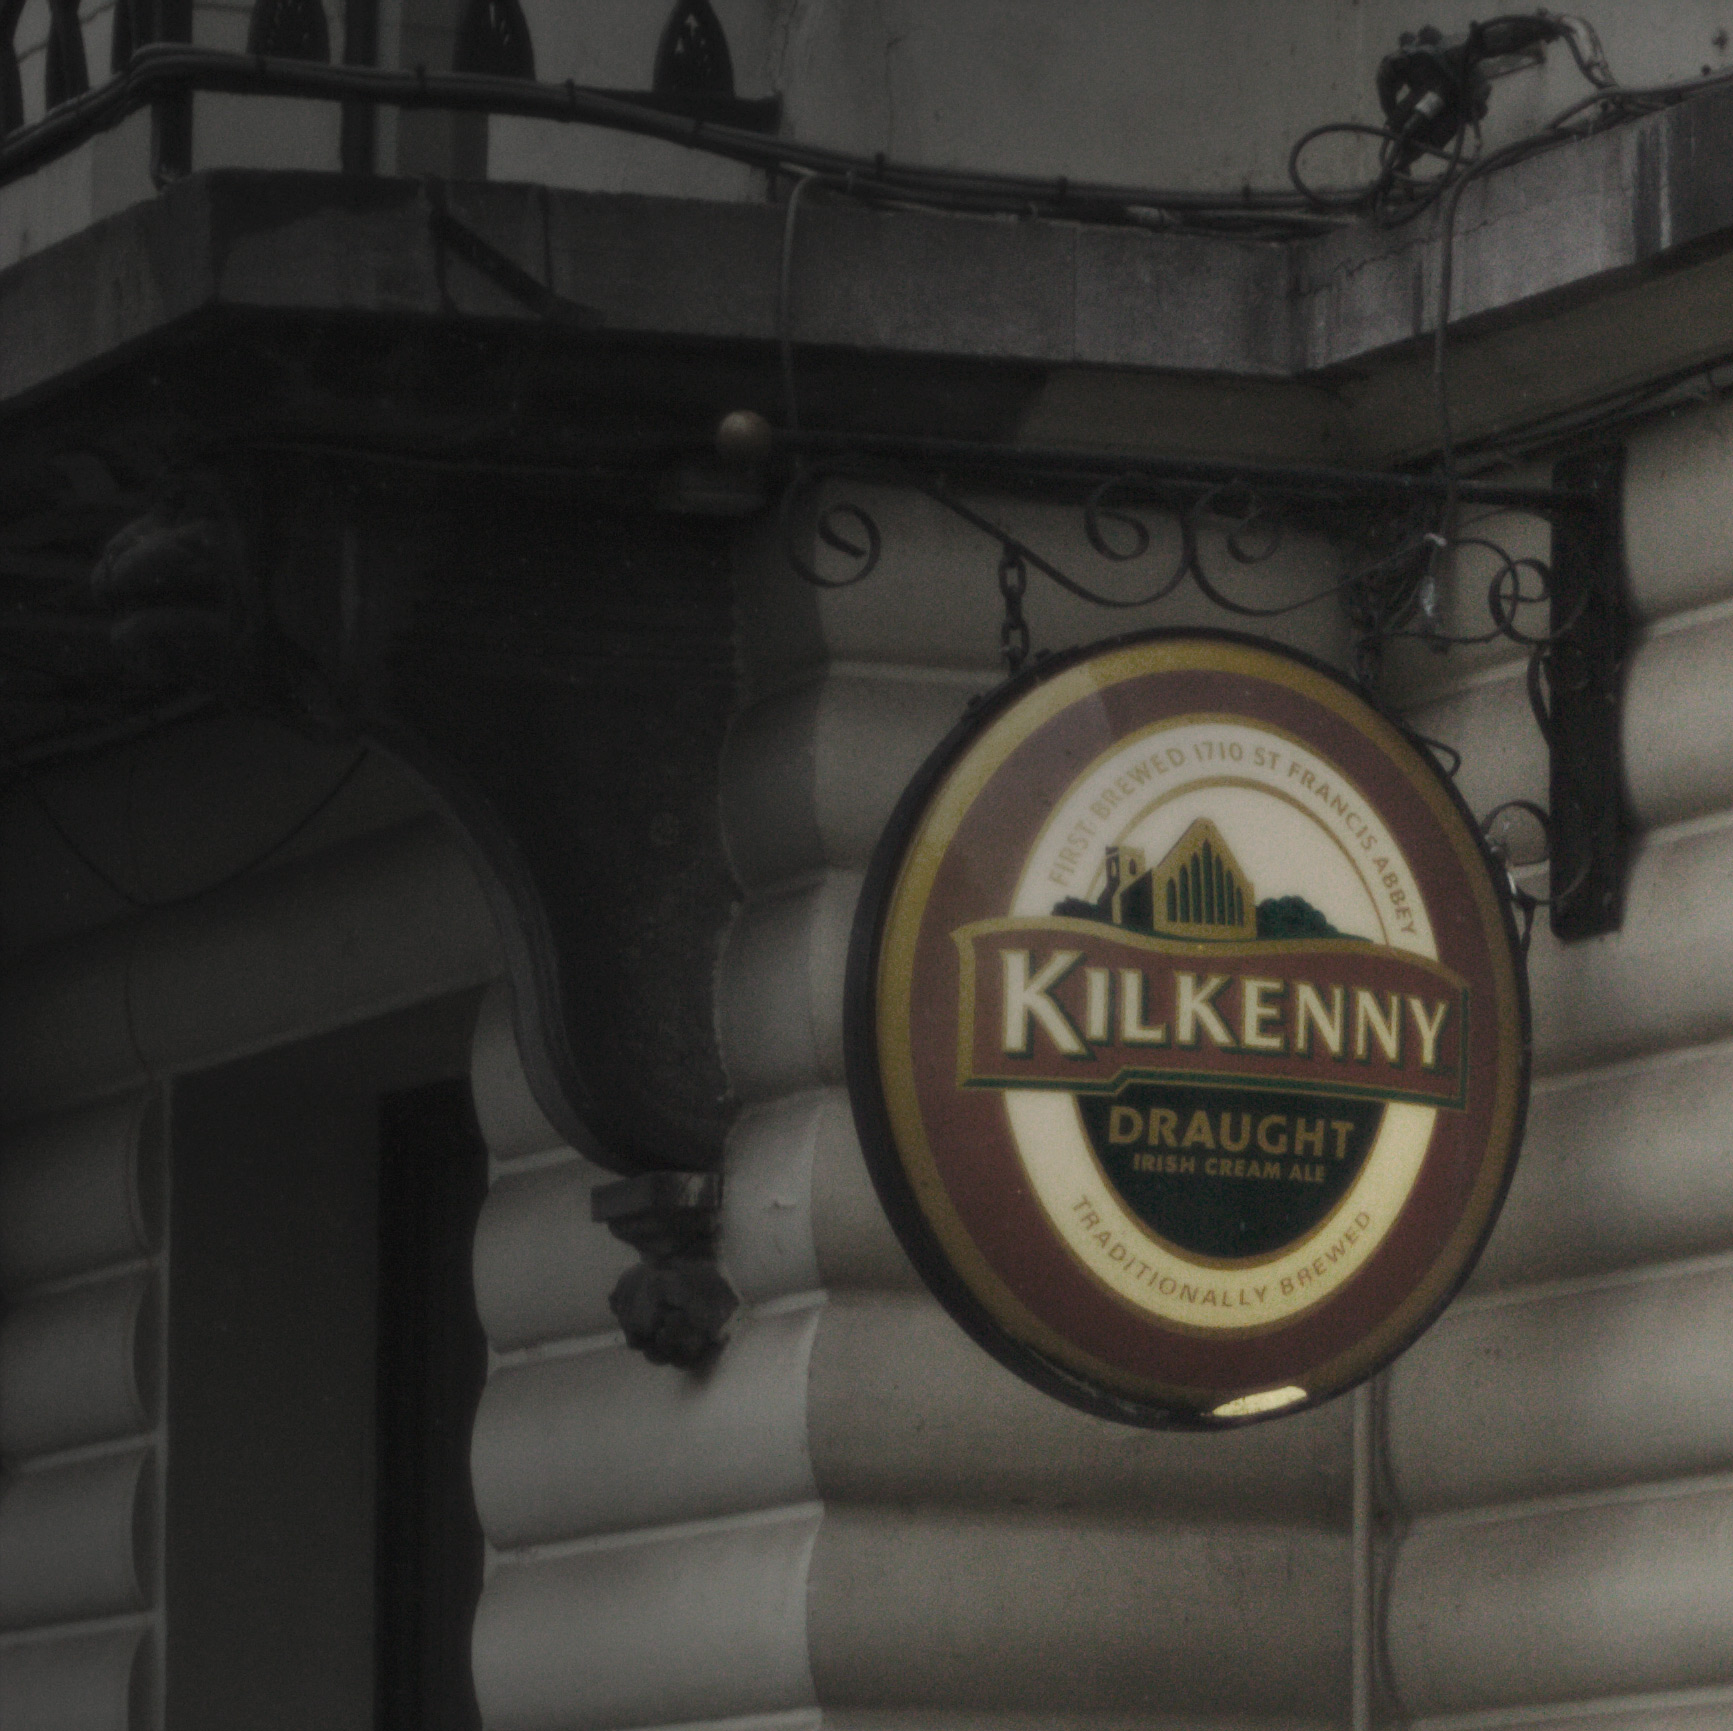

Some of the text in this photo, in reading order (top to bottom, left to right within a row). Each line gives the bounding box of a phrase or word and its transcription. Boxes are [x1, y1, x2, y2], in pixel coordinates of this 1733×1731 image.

[1048, 740, 1418, 937] FIRST BREWED 1710 ST FRANCIS ABBEY
[1000, 948, 1446, 1067] KILKENNY
[1108, 1106, 1354, 1159] DRAUGHT
[1133, 1153, 1326, 1183] IRISH CREAM ALE
[1072, 1195, 1372, 1308] TRADITIONALLY BREWED
